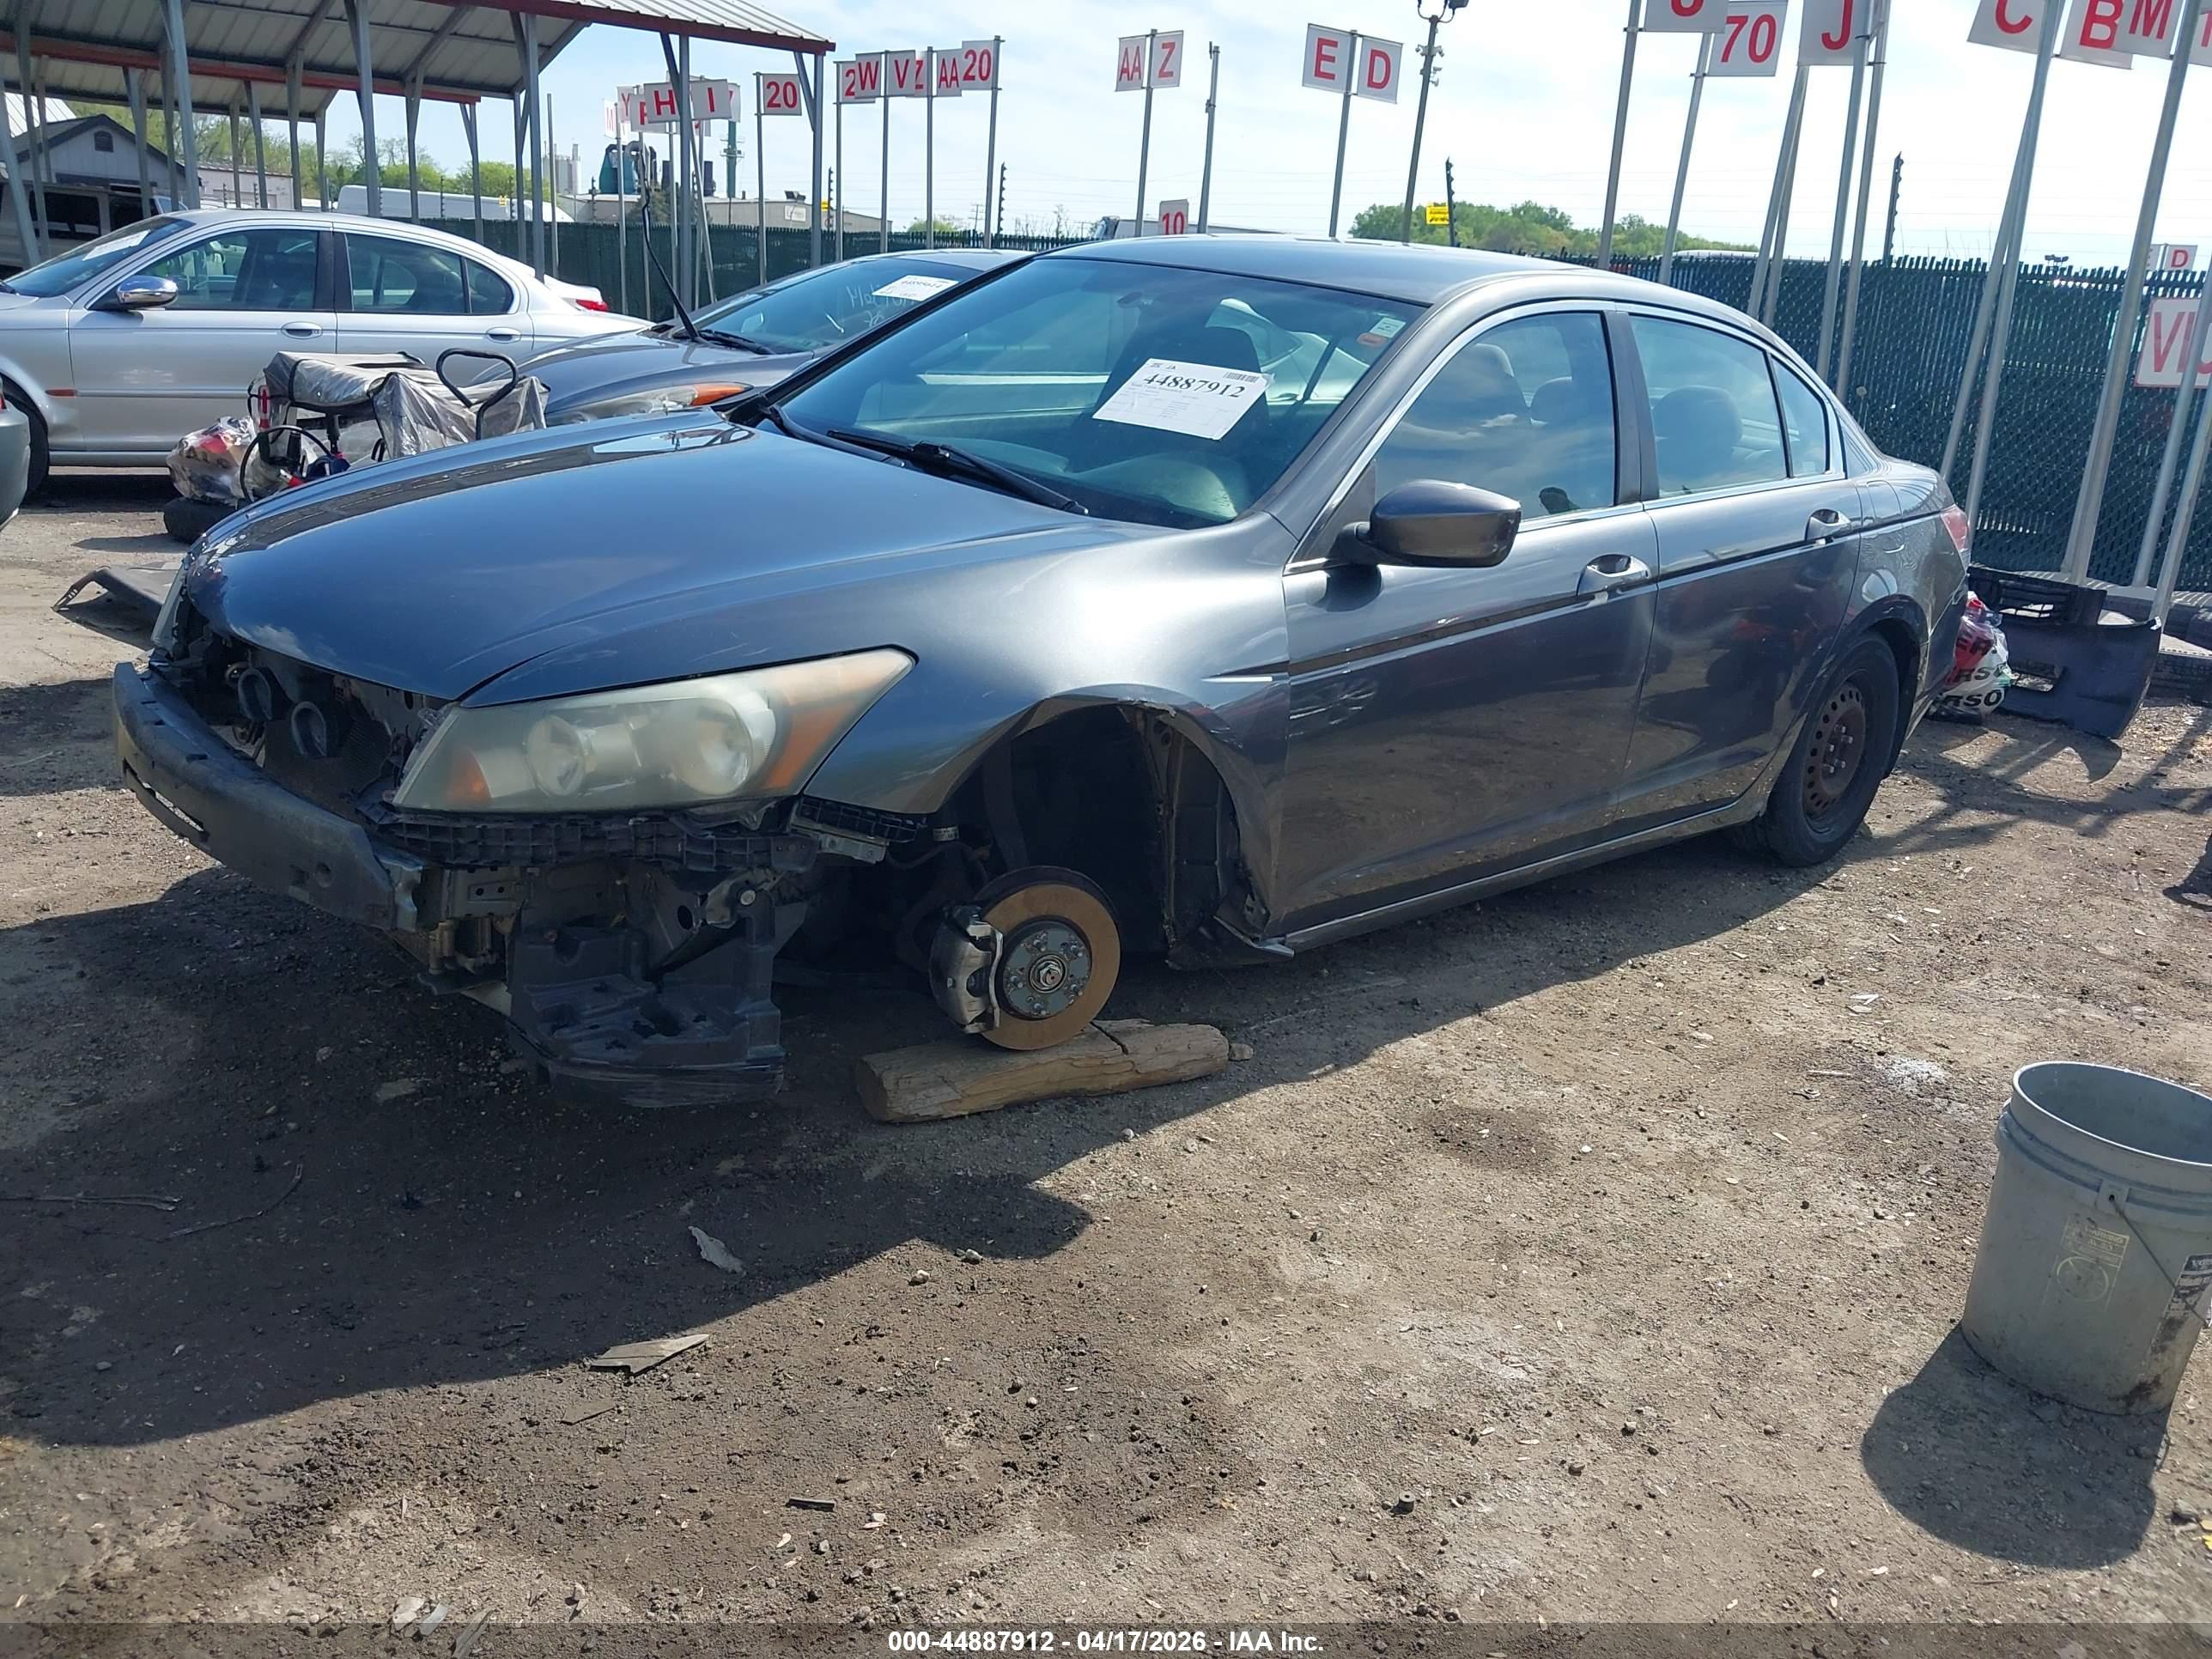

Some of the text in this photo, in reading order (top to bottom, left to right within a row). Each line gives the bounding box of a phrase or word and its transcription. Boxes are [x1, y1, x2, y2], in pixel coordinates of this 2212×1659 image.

[1721, 14, 1777, 63] 70
[2079, 0, 2124, 49] B
[939, 58, 959, 88] AA
[963, 49, 992, 82] 20
[1119, 46, 1142, 82] AA
[1158, 42, 1176, 78] Z
[1314, 37, 1338, 80] E
[1367, 49, 1391, 89] D
[858, 61, 879, 90] W
[895, 59, 910, 89] V
[621, 93, 630, 117] Y
[653, 89, 676, 116] H
[707, 87, 715, 112] I
[766, 81, 798, 108] 20
[1163, 211, 1185, 235] 10
[2170, 249, 2189, 268] D
[1144, 373, 1246, 398] 44887912
